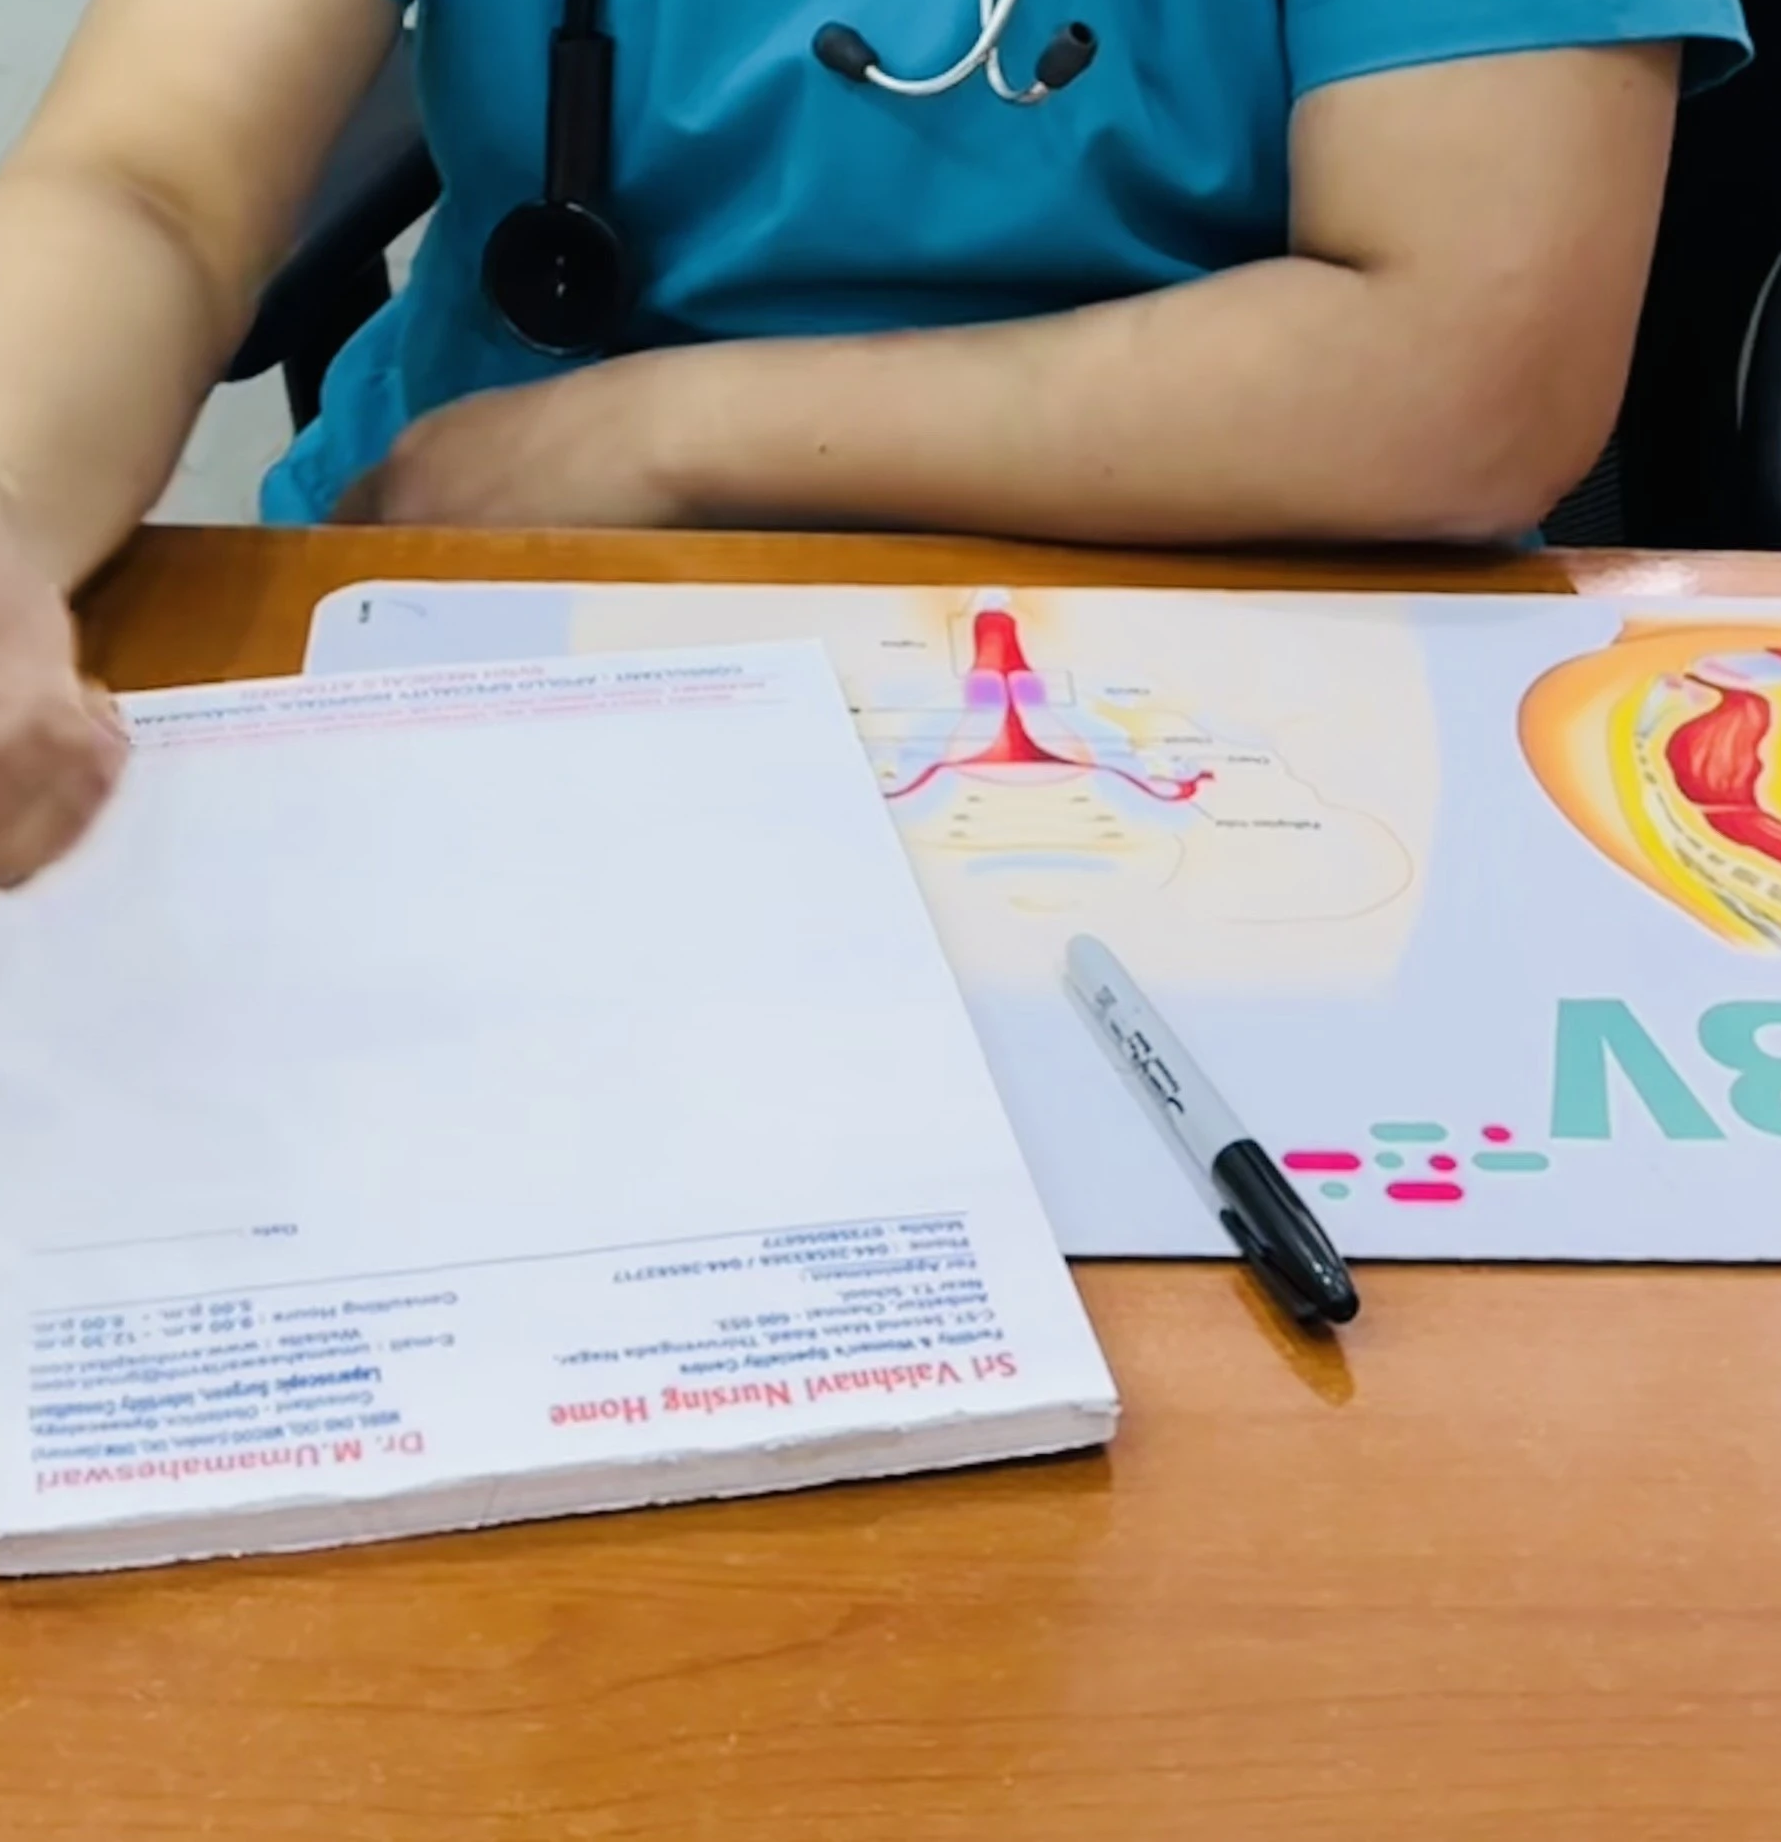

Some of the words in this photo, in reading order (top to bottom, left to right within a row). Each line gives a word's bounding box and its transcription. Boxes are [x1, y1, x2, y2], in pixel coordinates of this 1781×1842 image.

[804, 1361, 961, 1402] Vaishnavi
[970, 1352, 1017, 1381] Sri
[549, 1396, 648, 1427] Home
[661, 1381, 791, 1416] Nursing
[374, 1431, 424, 1455] Dr.
[35, 1439, 362, 1494] M.Umamaheswari
